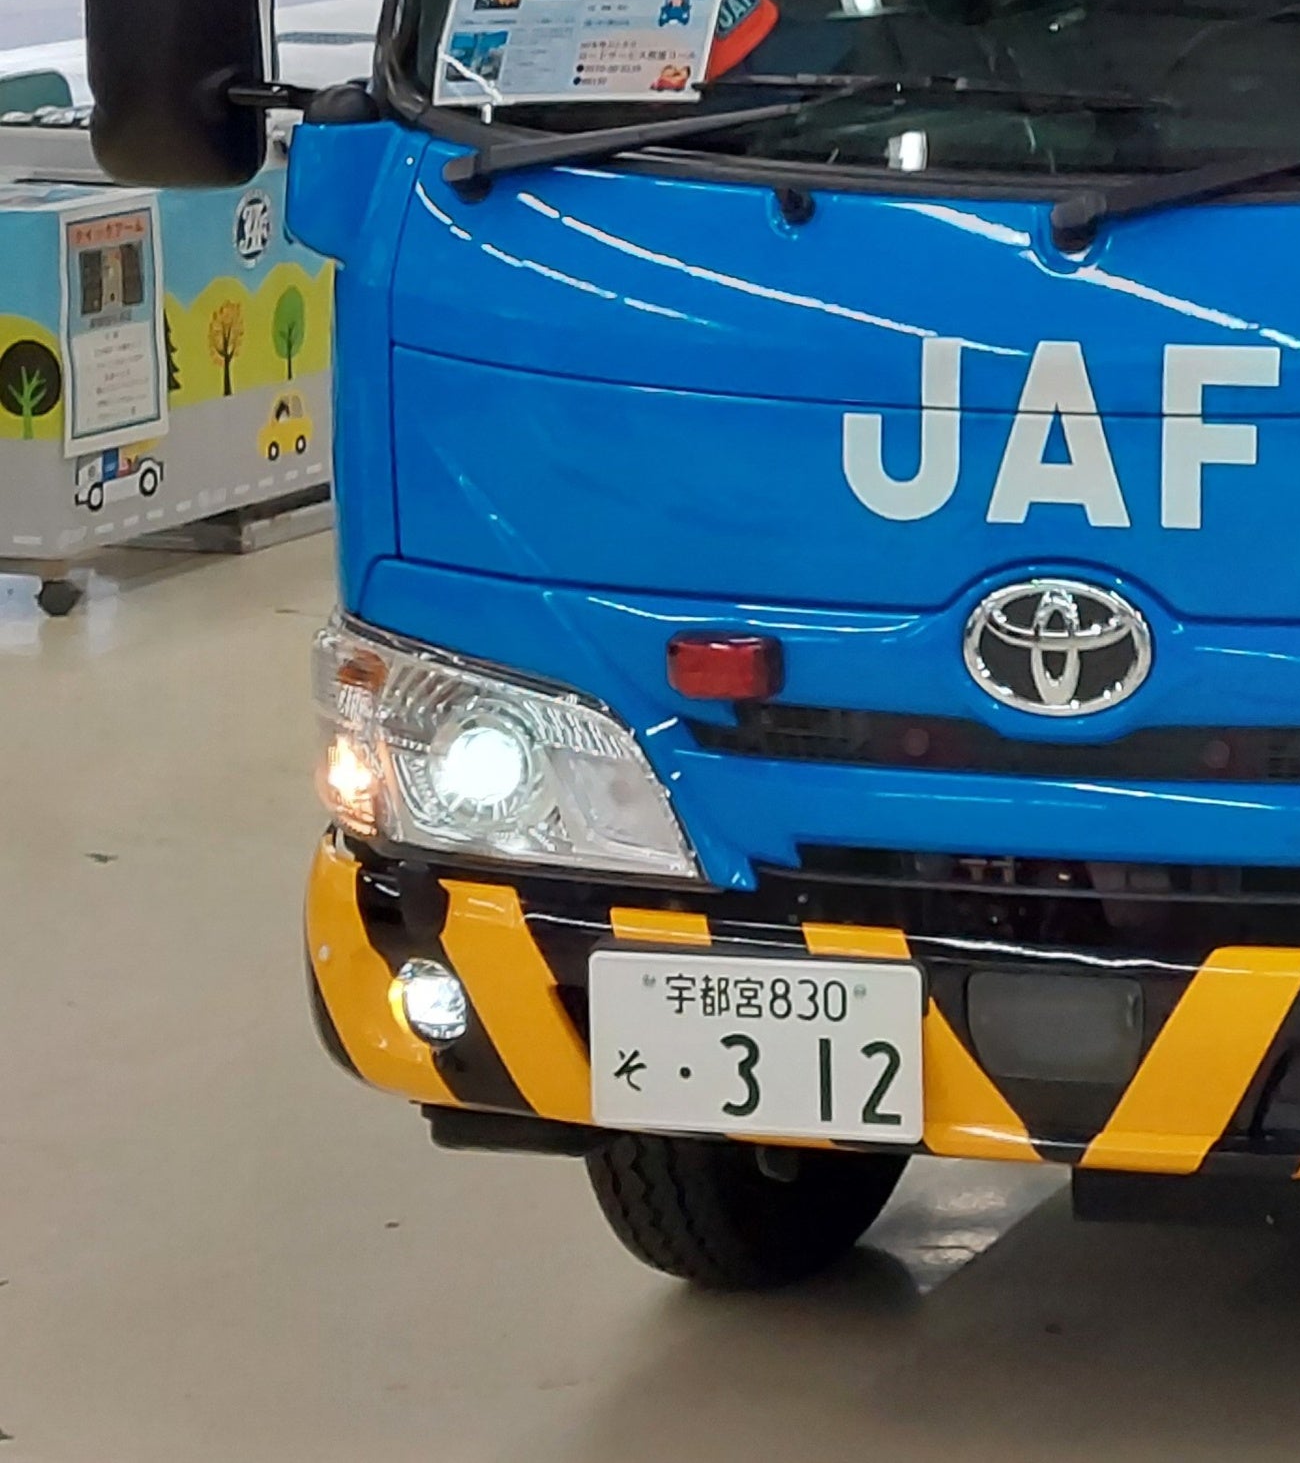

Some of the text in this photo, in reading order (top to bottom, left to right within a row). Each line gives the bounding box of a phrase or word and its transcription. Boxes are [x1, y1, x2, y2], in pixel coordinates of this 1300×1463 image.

[843, 337, 1280, 529] JAF
[665, 973, 849, 1022] 宇都宮830
